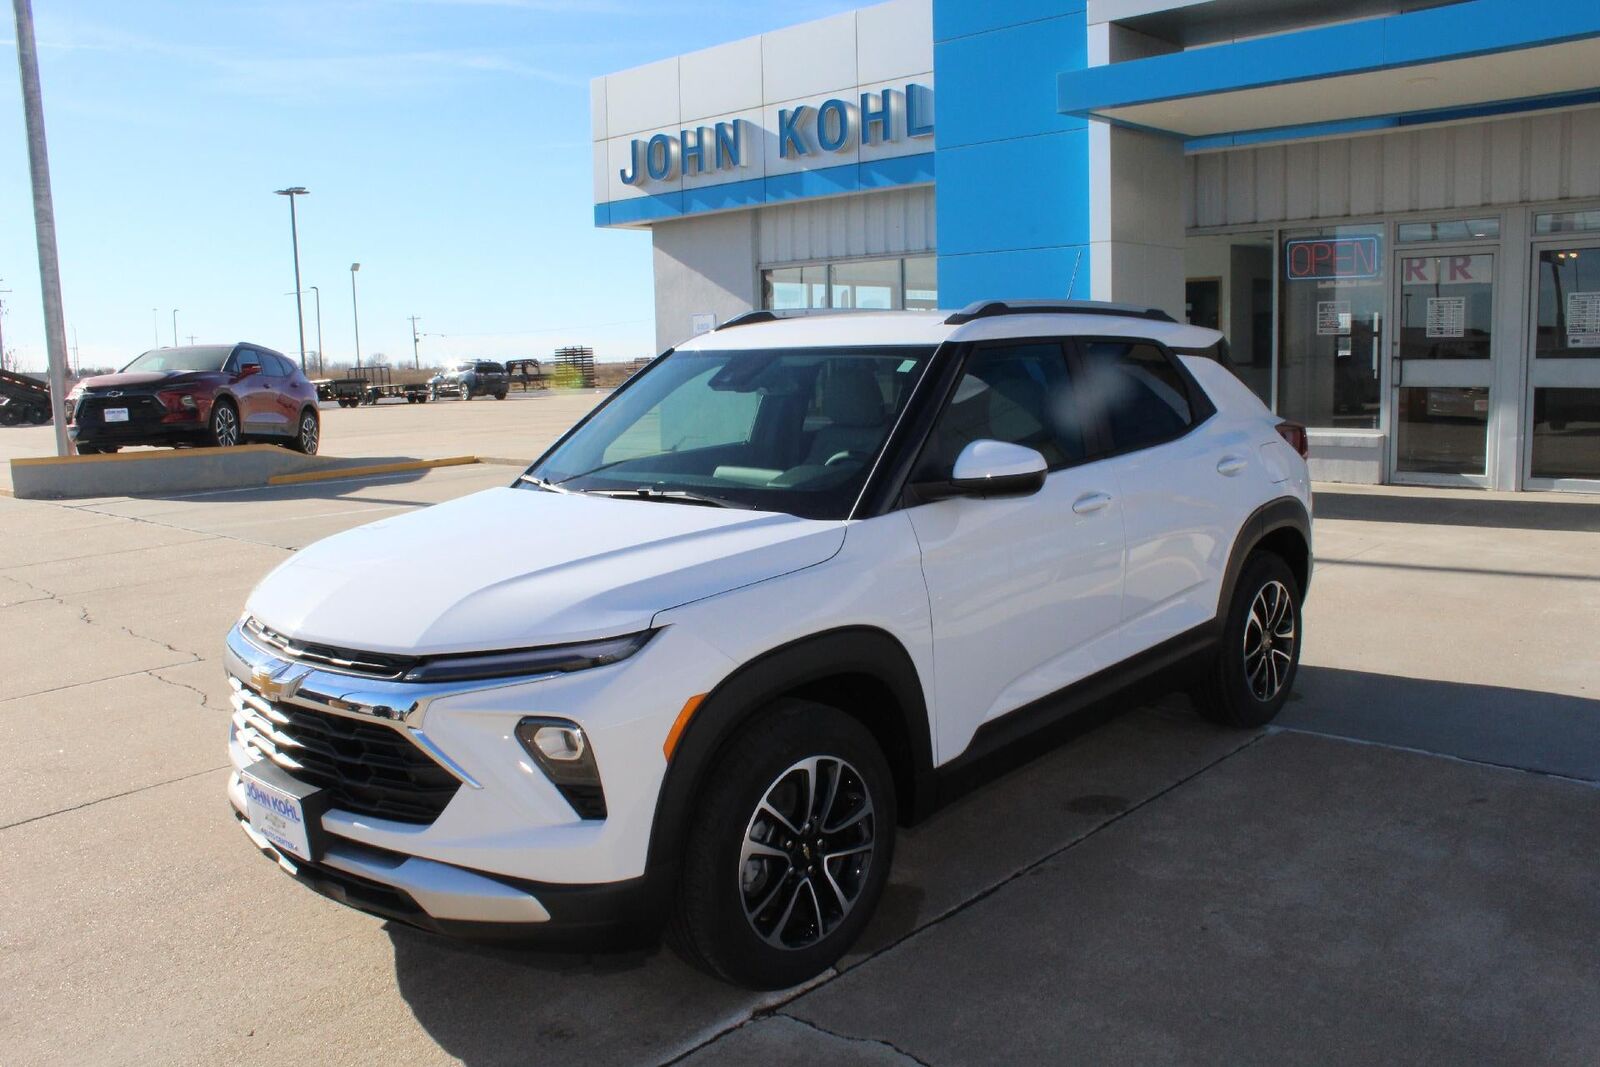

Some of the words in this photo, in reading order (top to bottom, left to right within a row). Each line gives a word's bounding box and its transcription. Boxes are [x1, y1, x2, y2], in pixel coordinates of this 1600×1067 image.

[620, 118, 747, 186] JOHN
[778, 84, 934, 160] KOHL
[1291, 242, 1374, 275] OPEN
[246, 782, 272, 808] JOHN
[271, 796, 301, 822] KOHL
